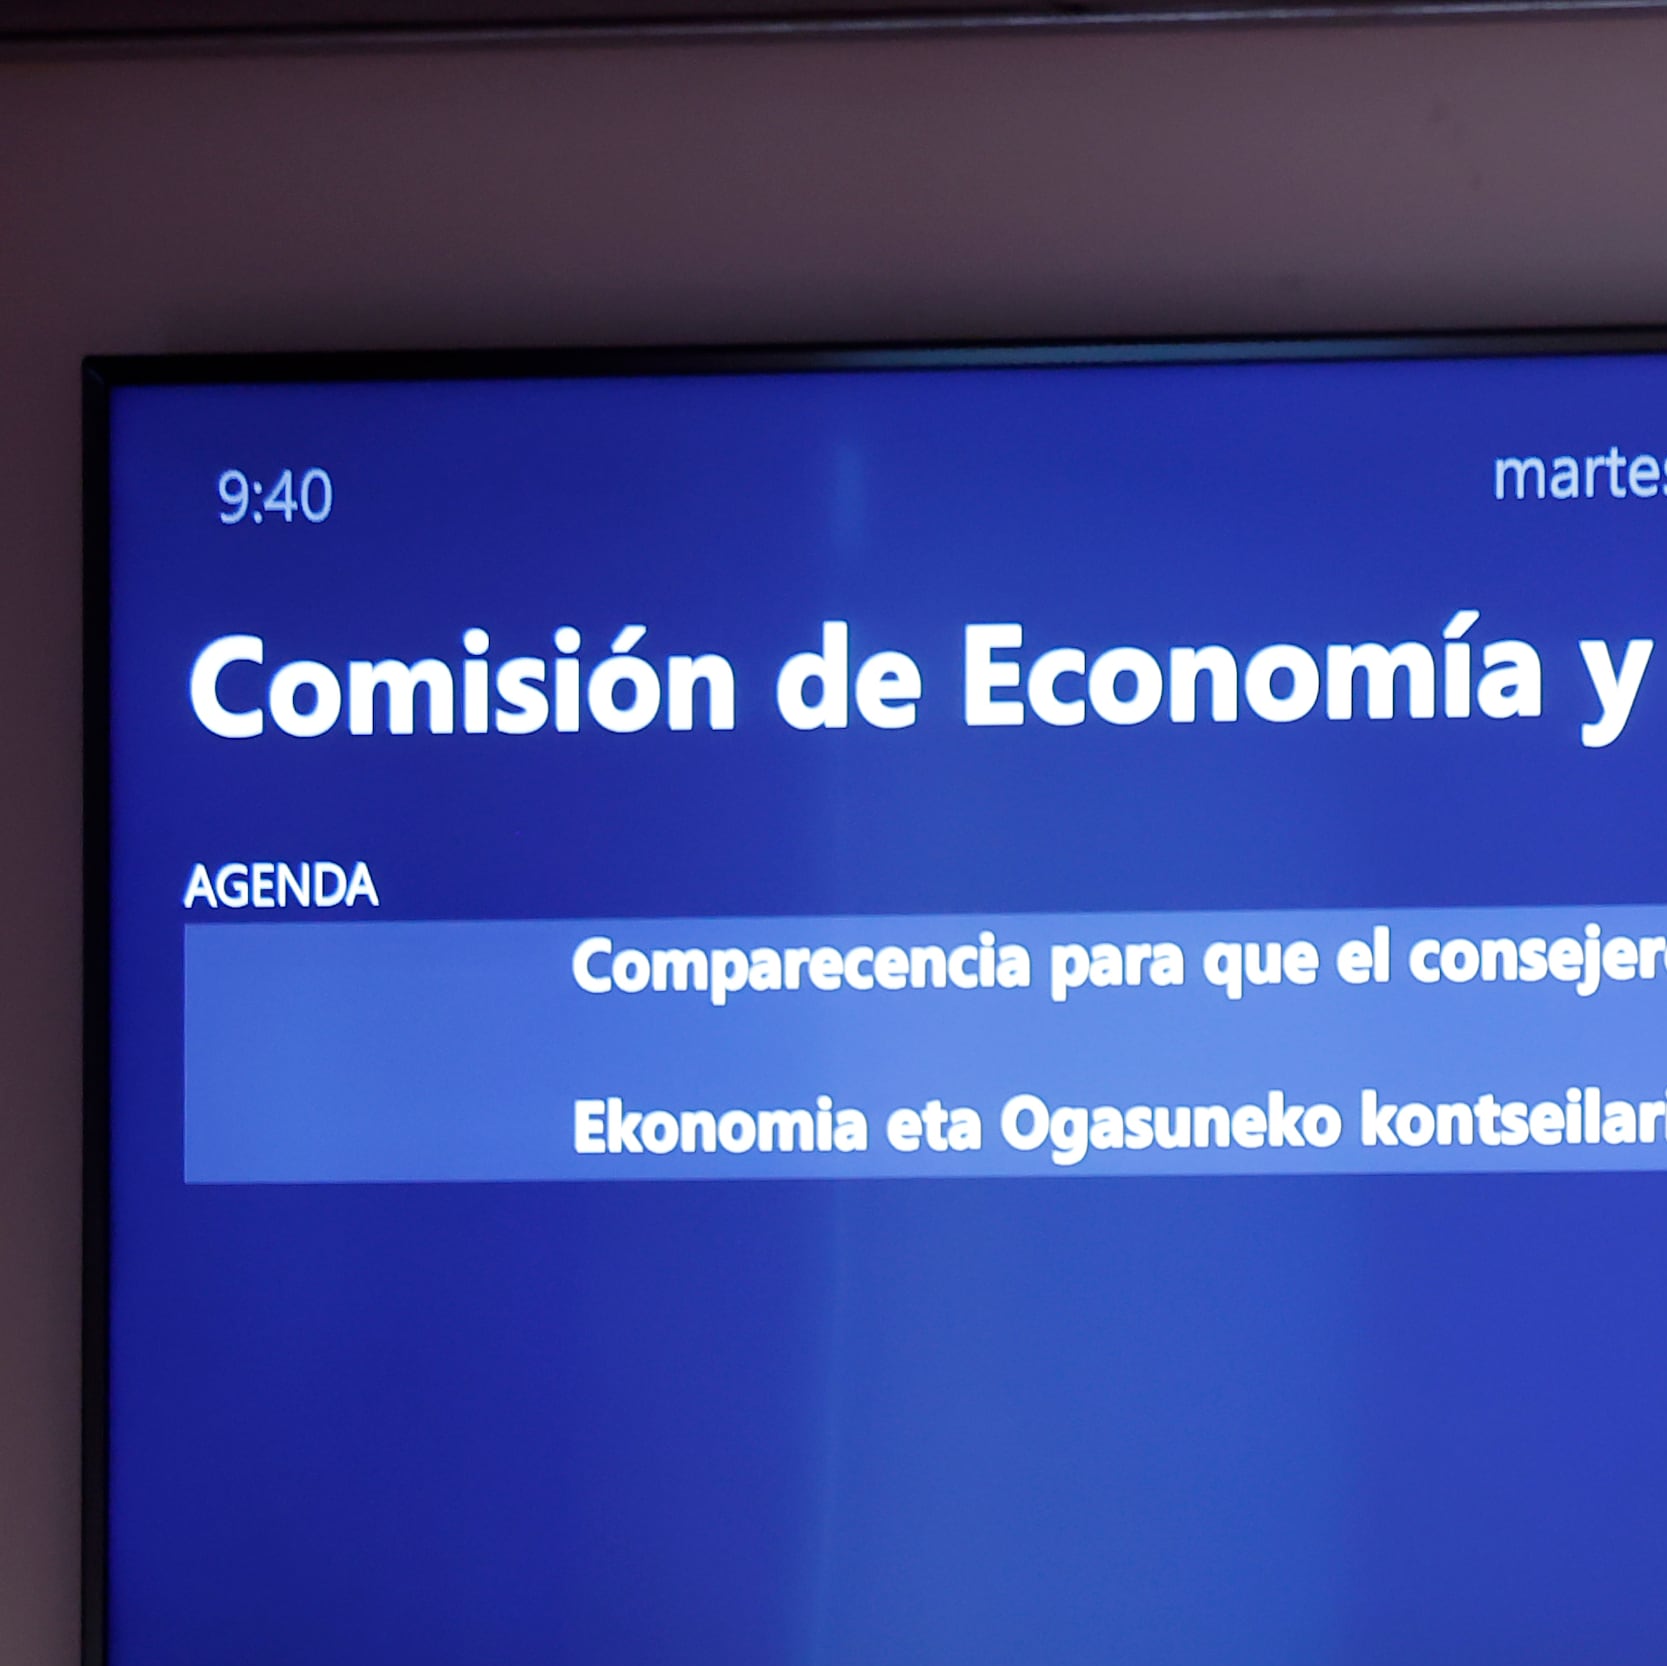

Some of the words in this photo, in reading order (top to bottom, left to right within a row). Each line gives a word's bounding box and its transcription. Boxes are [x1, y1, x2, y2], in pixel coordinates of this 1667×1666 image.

[219, 469, 332, 523] 9:40
[190, 625, 735, 738] Comisión
[777, 621, 922, 730] de
[965, 610, 1541, 726] Economía
[1579, 639, 1654, 748] y
[184, 862, 379, 908] AGENDA
[572, 931, 1031, 1006] Comparecencia
[1051, 942, 1184, 1002] para
[1203, 941, 1319, 1000] que
[1337, 925, 1390, 984] el
[574, 1095, 868, 1154] Ekonomia
[887, 1099, 982, 1152] eta
[1001, 1090, 1342, 1166] Ogasuneko
